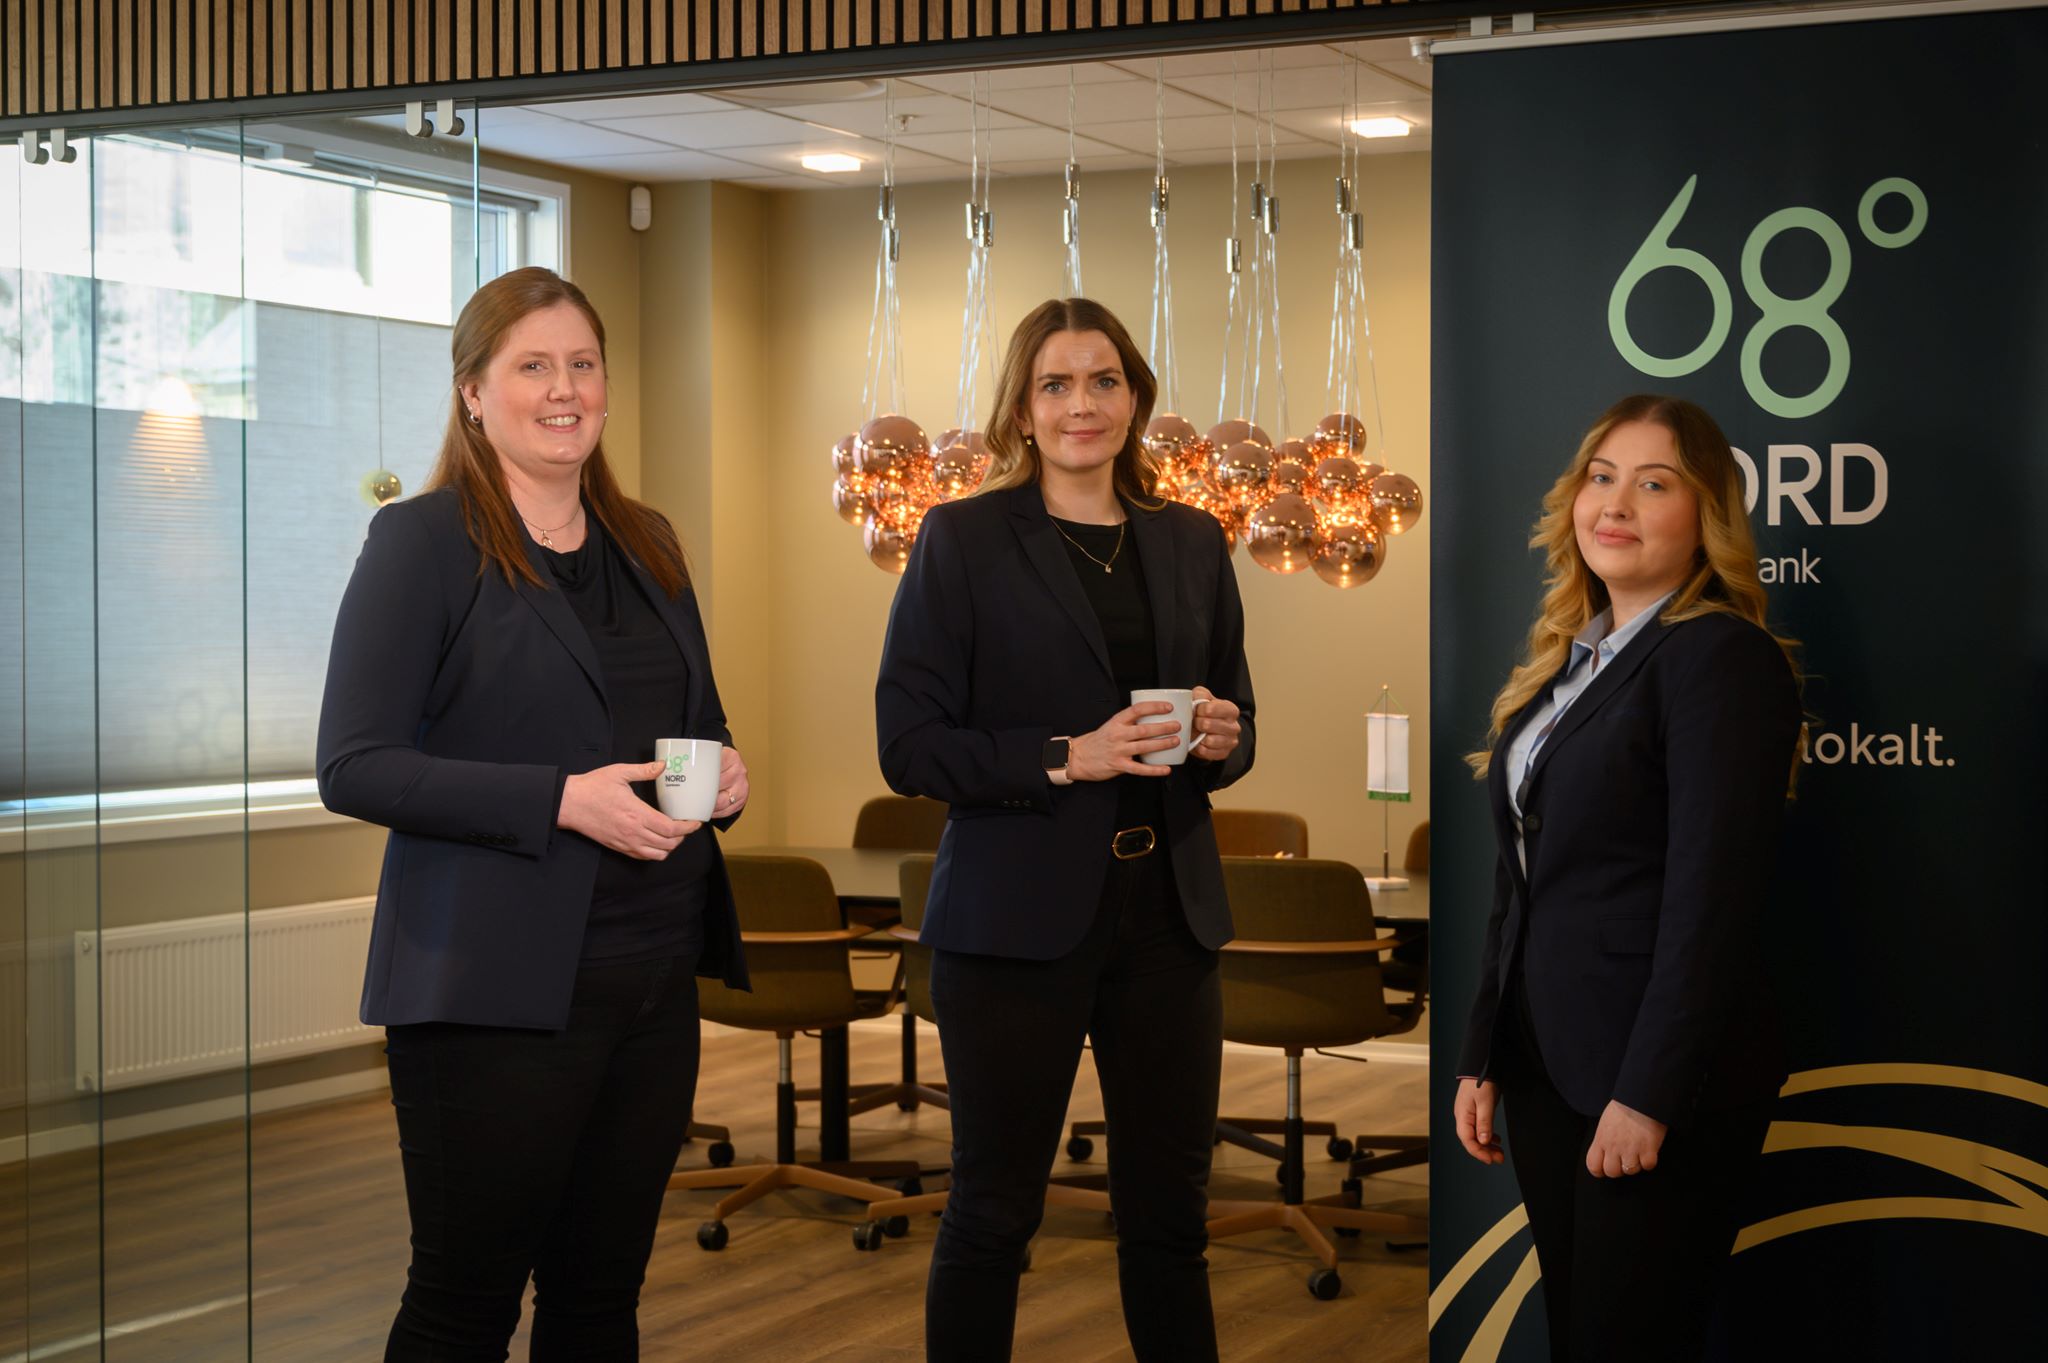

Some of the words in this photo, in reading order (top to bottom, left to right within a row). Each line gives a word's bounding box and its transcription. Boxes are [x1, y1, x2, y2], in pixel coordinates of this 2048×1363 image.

[1729, 443, 1889, 526] RD
[1758, 547, 1822, 584] ank
[665, 774, 687, 783] NORD
